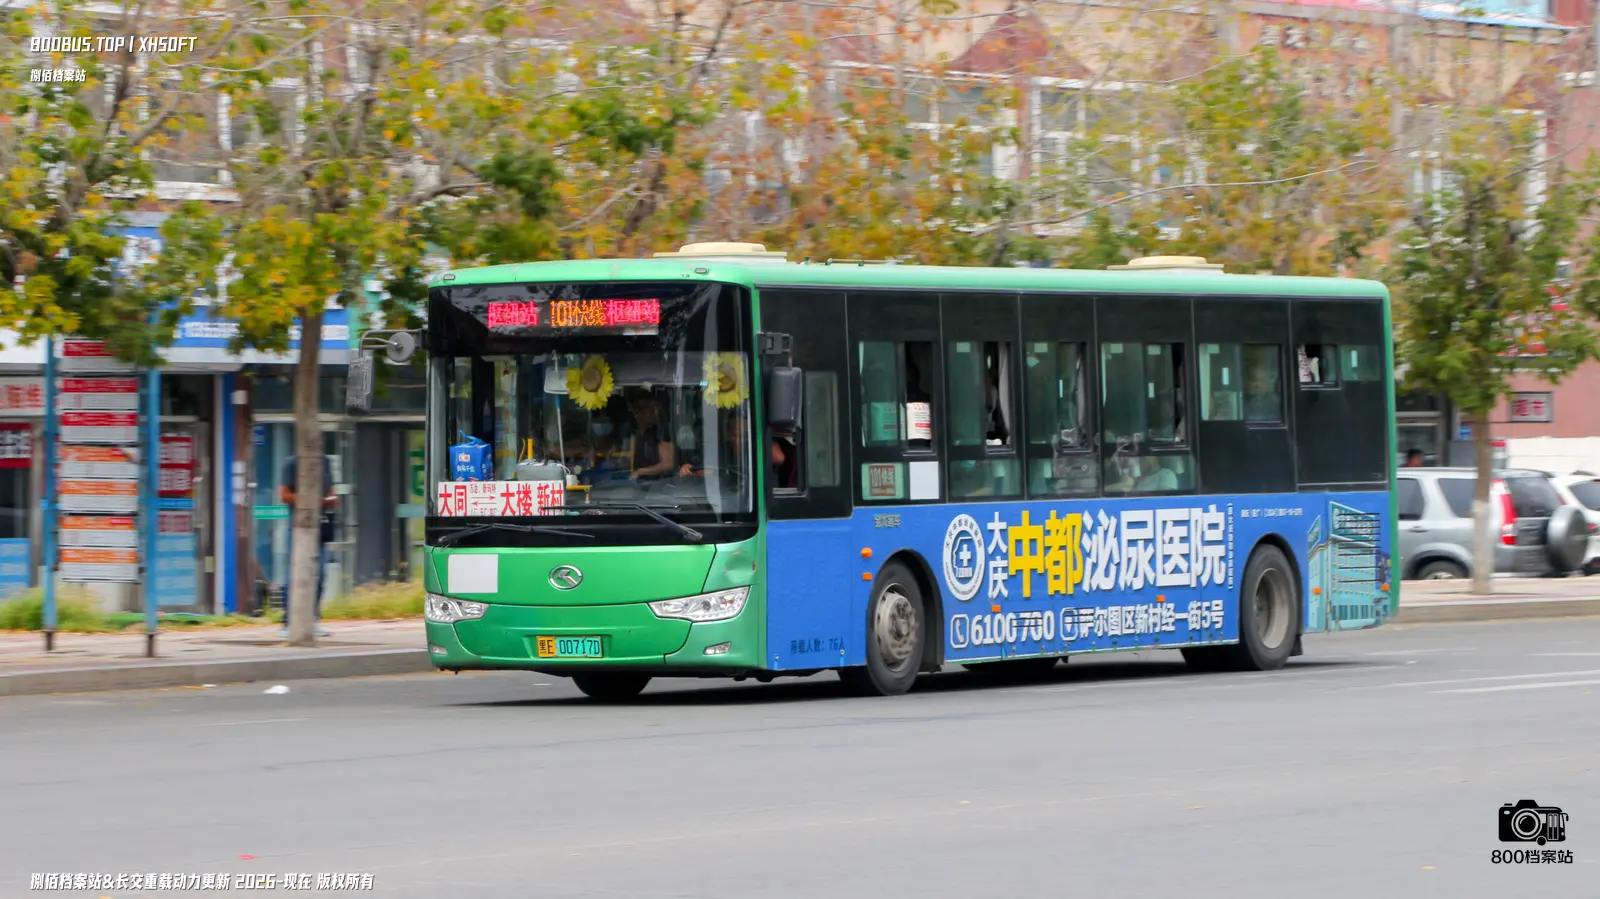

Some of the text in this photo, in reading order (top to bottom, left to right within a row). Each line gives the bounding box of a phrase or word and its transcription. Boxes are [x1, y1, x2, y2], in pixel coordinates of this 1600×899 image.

[439, 484, 467, 516] 大同
[500, 483, 533, 516] 大楼
[986, 511, 1009, 599] 大庆
[1008, 504, 1226, 598] 中都泌尿医院
